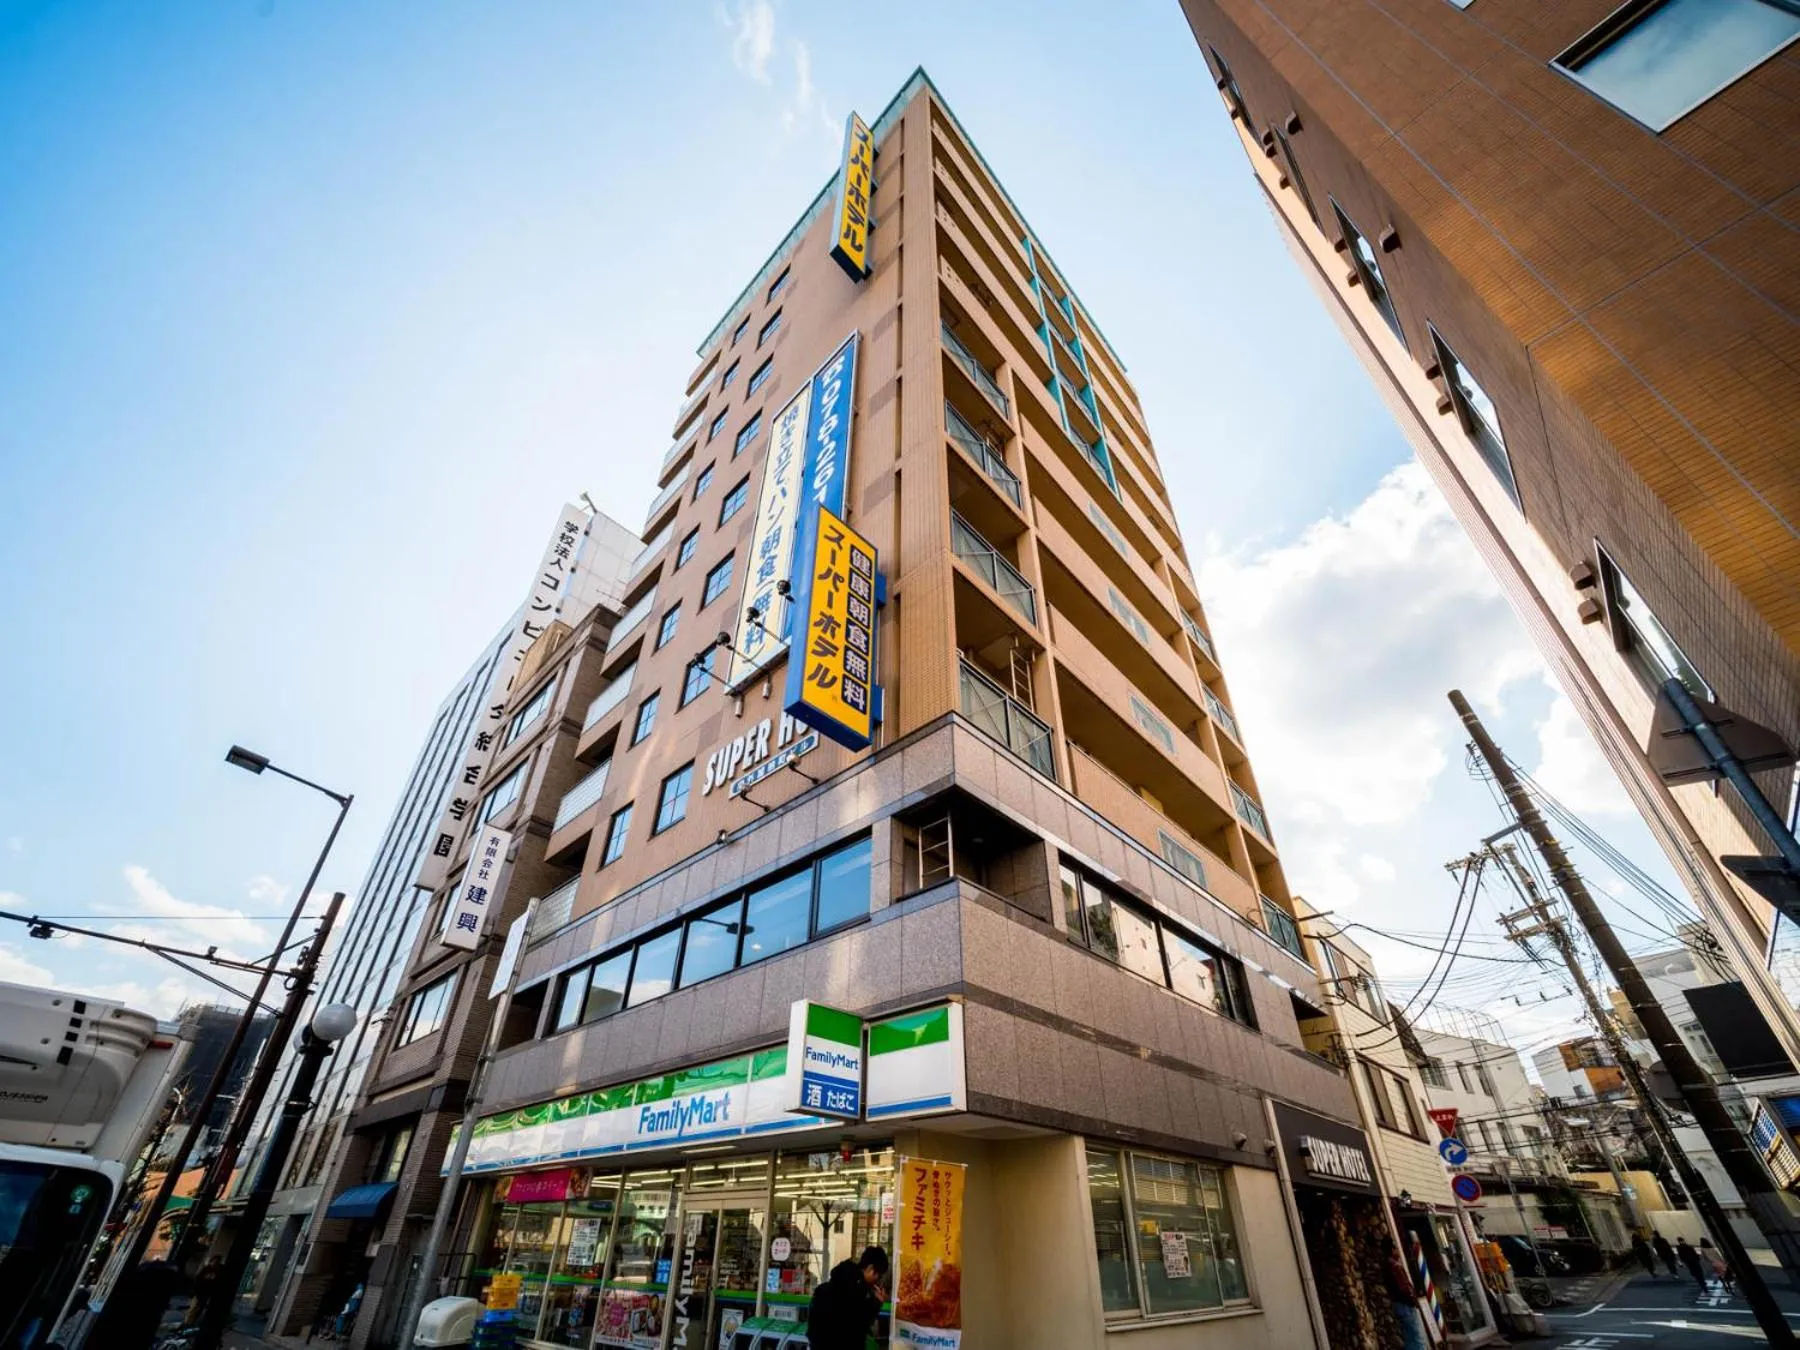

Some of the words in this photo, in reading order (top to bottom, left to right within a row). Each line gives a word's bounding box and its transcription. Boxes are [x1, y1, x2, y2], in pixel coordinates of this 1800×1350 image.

[843, 123, 870, 253] スーパーホテル
[807, 524, 844, 689] スーパーホテル
[843, 546, 872, 711] 健康朝食無料
[702, 718, 772, 796] SUPER
[805, 1046, 859, 1070] FamilyMart
[638, 1091, 731, 1137] FamilyMart
[806, 1084, 822, 1108] 酒
[827, 1089, 855, 1111] たばこ
[1307, 1135, 1344, 1178] SUPER
[1338, 1144, 1371, 1182] HOTEL
[911, 1167, 928, 1251] ファミチキ
[912, 1332, 956, 1348] FamilyMart
